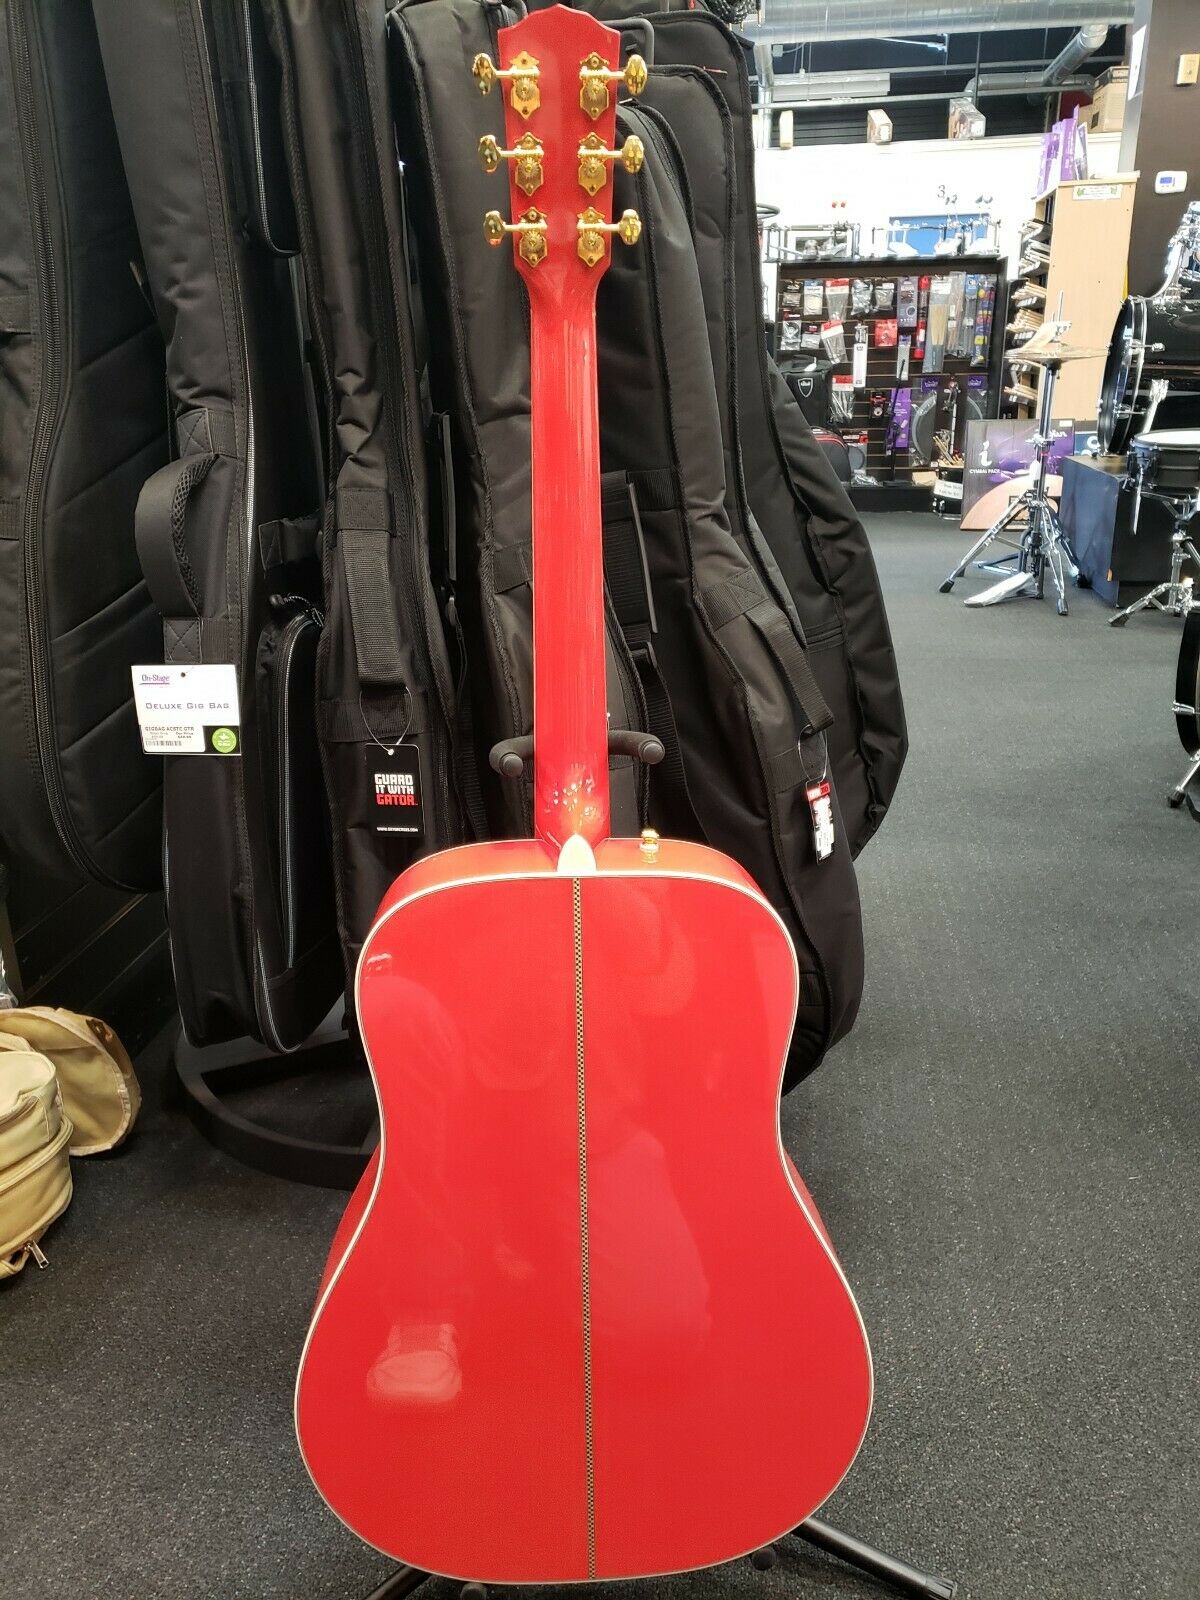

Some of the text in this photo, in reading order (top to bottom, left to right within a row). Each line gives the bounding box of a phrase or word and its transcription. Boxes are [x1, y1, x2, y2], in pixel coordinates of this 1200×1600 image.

[374, 773, 414, 786] GUARD
[375, 785, 414, 795] IT WITH
